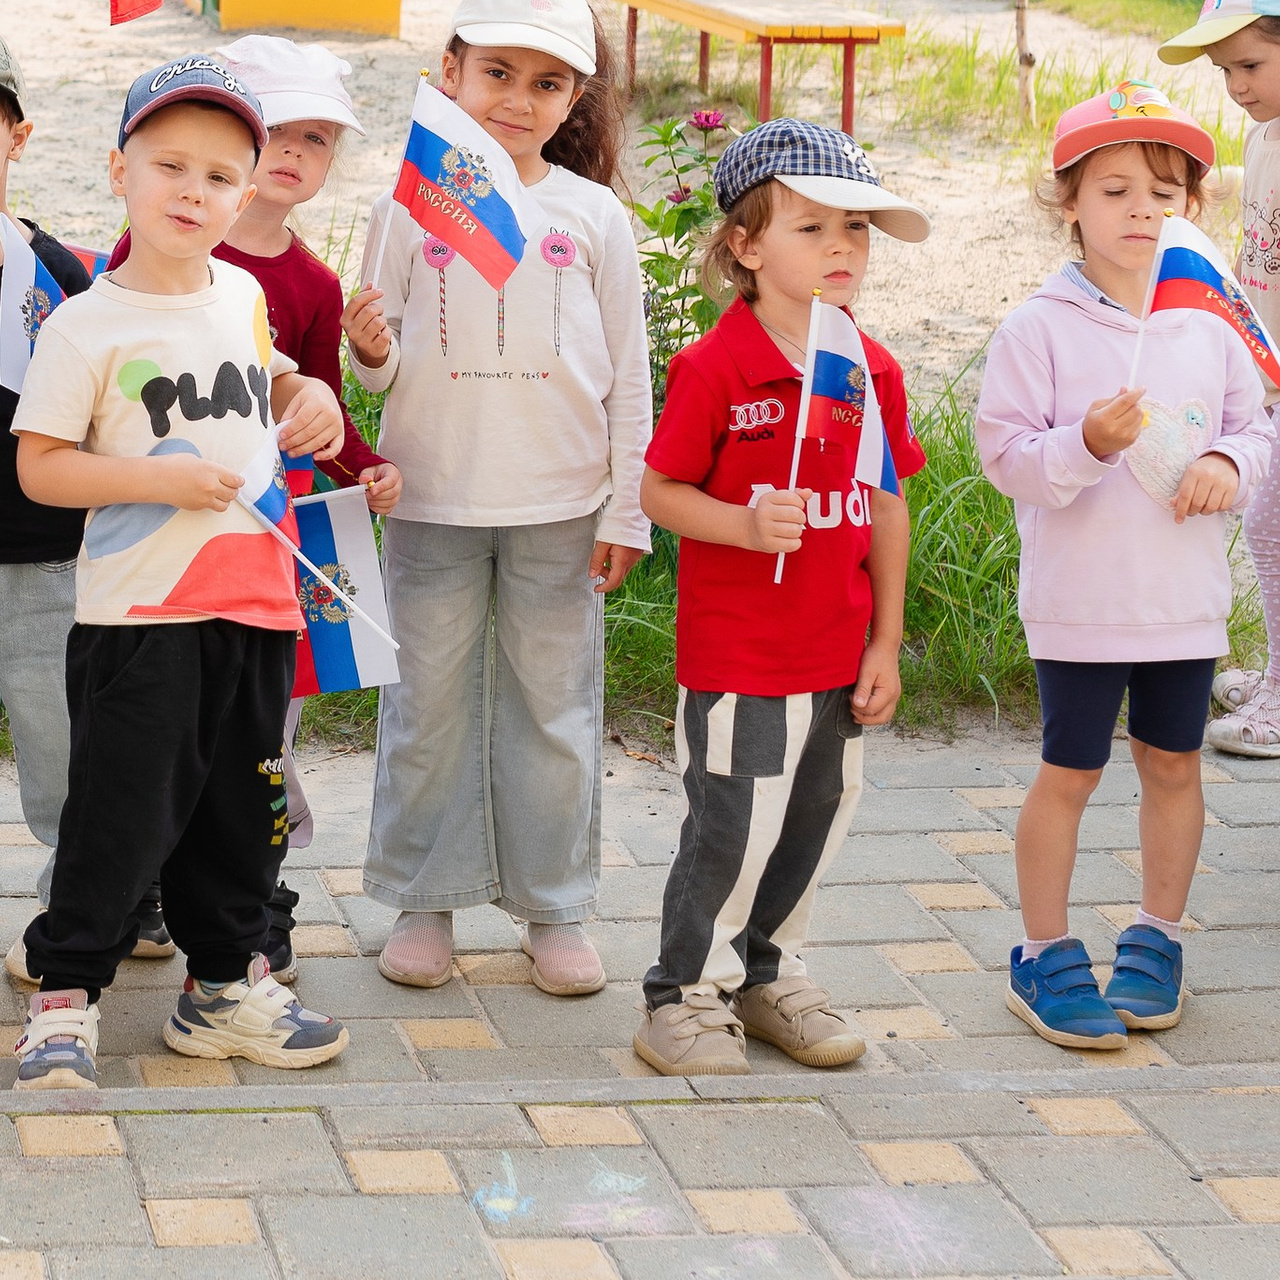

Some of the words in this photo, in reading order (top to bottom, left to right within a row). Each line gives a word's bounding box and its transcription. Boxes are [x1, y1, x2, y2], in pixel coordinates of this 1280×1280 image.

[417, 182, 479, 236] РОССИЯ
[462, 371, 472, 380] MY
[475, 371, 514, 380] FAVOURITE
[141, 361, 269, 438] PLAY
[736, 428, 775, 443] Audi
